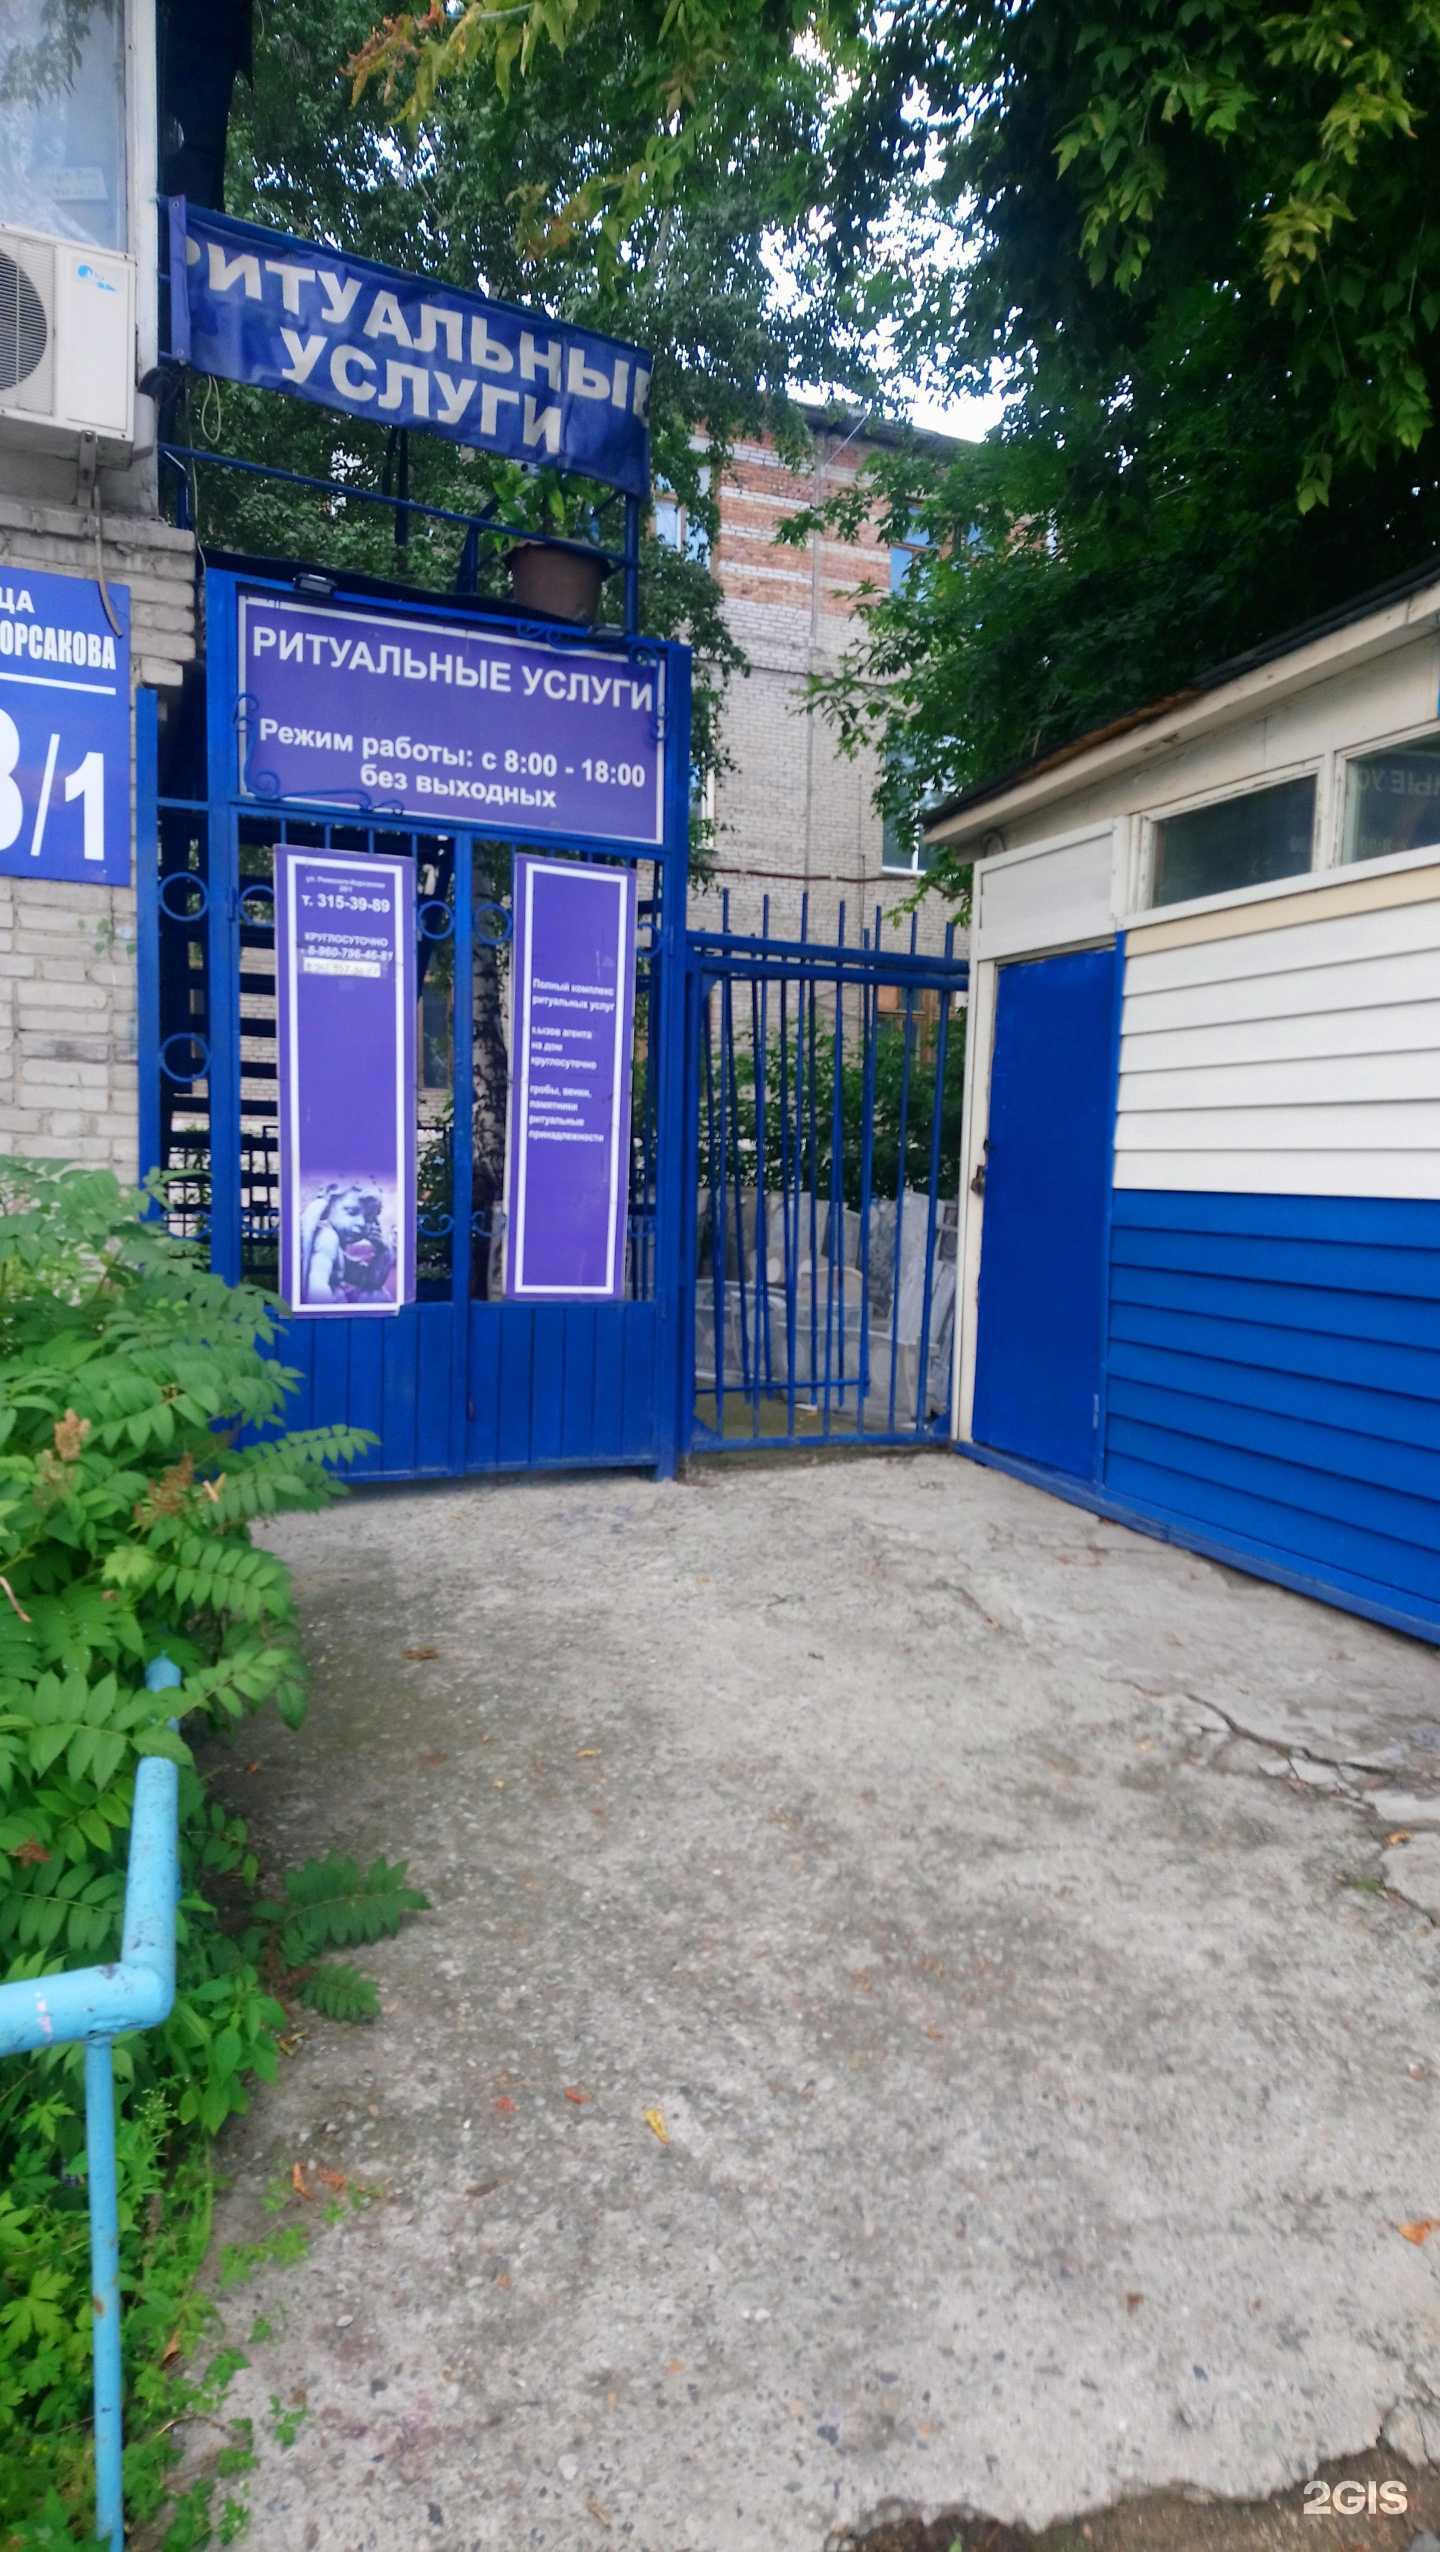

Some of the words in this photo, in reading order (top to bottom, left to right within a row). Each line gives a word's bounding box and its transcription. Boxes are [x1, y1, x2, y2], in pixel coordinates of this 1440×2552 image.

[280, 326, 562, 454] УСЛУГИ
[253, 625, 512, 693] РИТУАЛЬНЫЕ
[521, 665, 653, 712] УСЛУГИ
[259, 718, 353, 752] Режим
[362, 736, 473, 767] работы:
[481, 751, 497, 770] с
[504, 749, 558, 777] 8:00
[581, 757, 646, 788] 18:00
[360, 763, 408, 790] без
[416, 774, 557, 808] выходных
